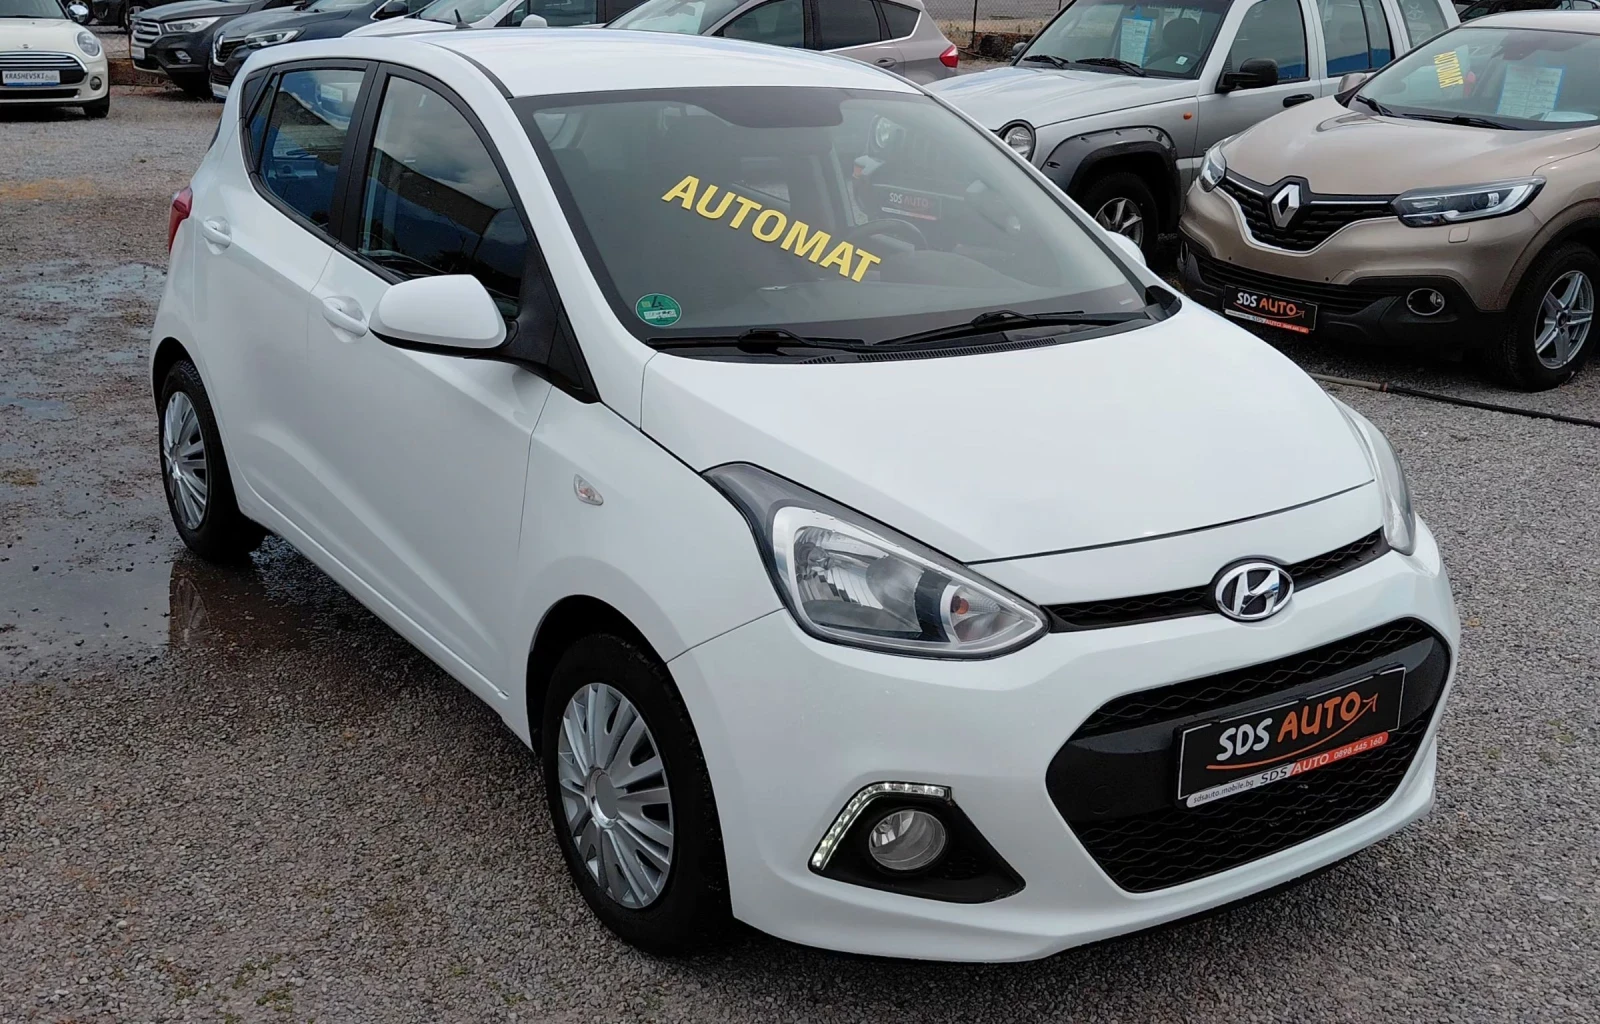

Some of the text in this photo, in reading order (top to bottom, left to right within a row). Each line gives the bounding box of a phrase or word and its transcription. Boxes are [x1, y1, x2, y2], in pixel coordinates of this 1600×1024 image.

[661, 175, 882, 284] AUTOMAT
[889, 192, 929, 208] SDS AUTO
[1236, 292, 1257, 307] SDS
[1259, 297, 1297, 315] AUTO
[1216, 692, 1361, 761] SDS AUTO
[1192, 737, 1384, 804] sdsauto.mobile.bg SDS AUTO 0898 445 160
